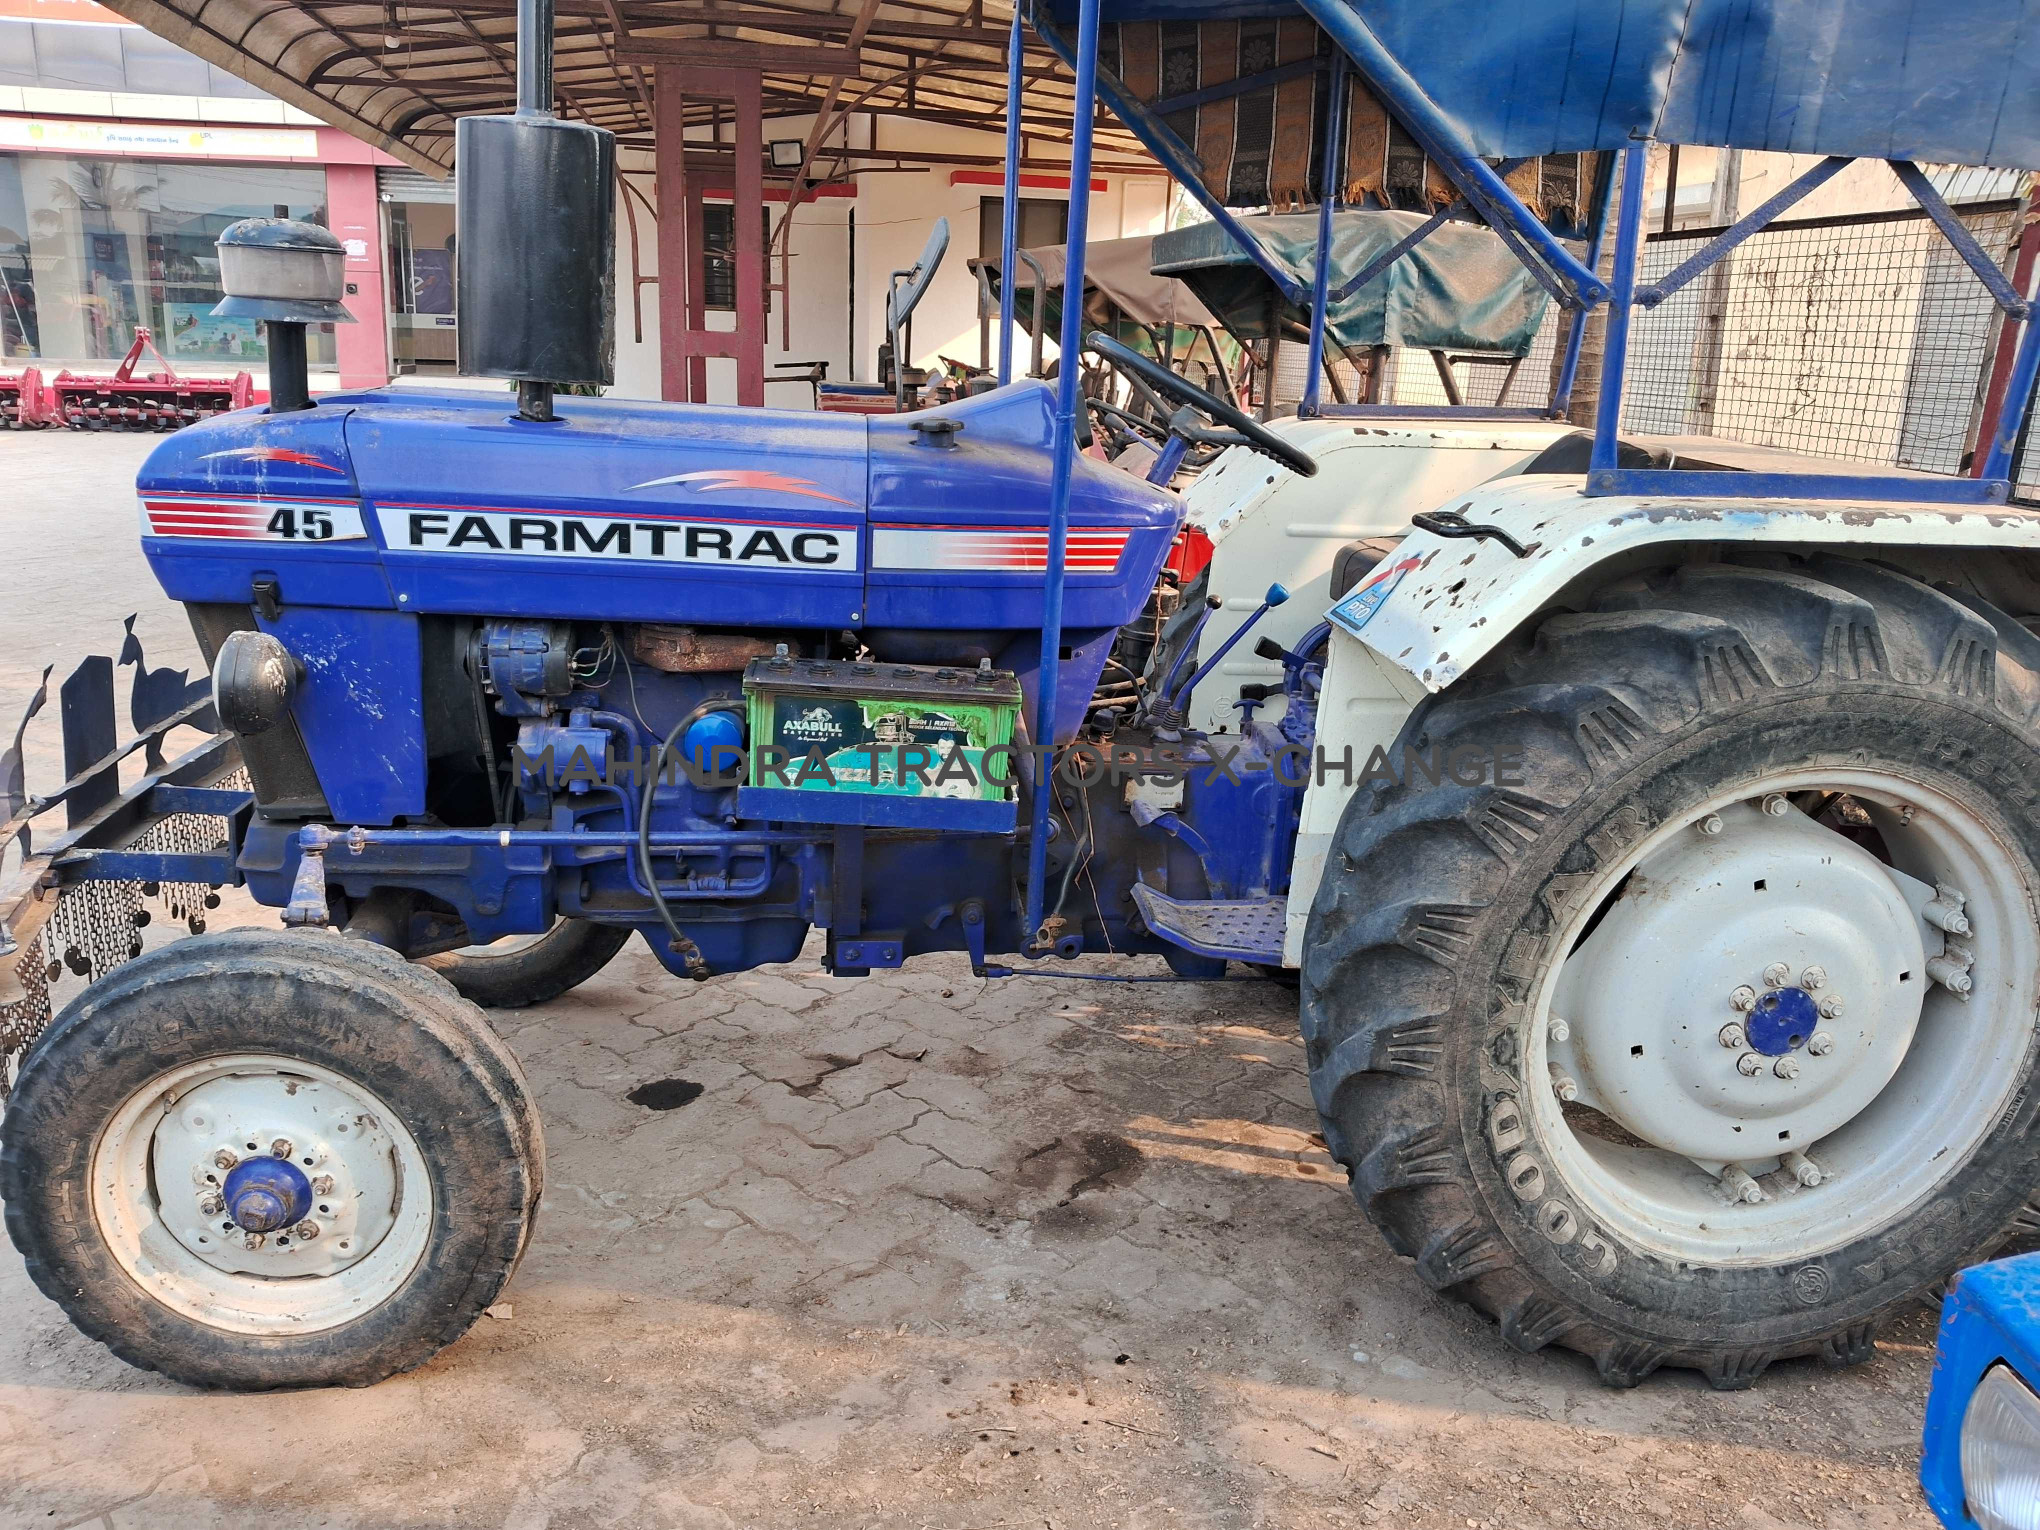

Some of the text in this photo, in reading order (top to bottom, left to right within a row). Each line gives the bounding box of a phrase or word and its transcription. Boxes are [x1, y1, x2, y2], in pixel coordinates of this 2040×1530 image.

[267, 509, 335, 541] 45
[409, 514, 839, 564] FARMTRAC
[1344, 601, 1371, 619] PTO
[782, 729, 843, 738] BATTERIES
[783, 720, 843, 732] AXABULL
